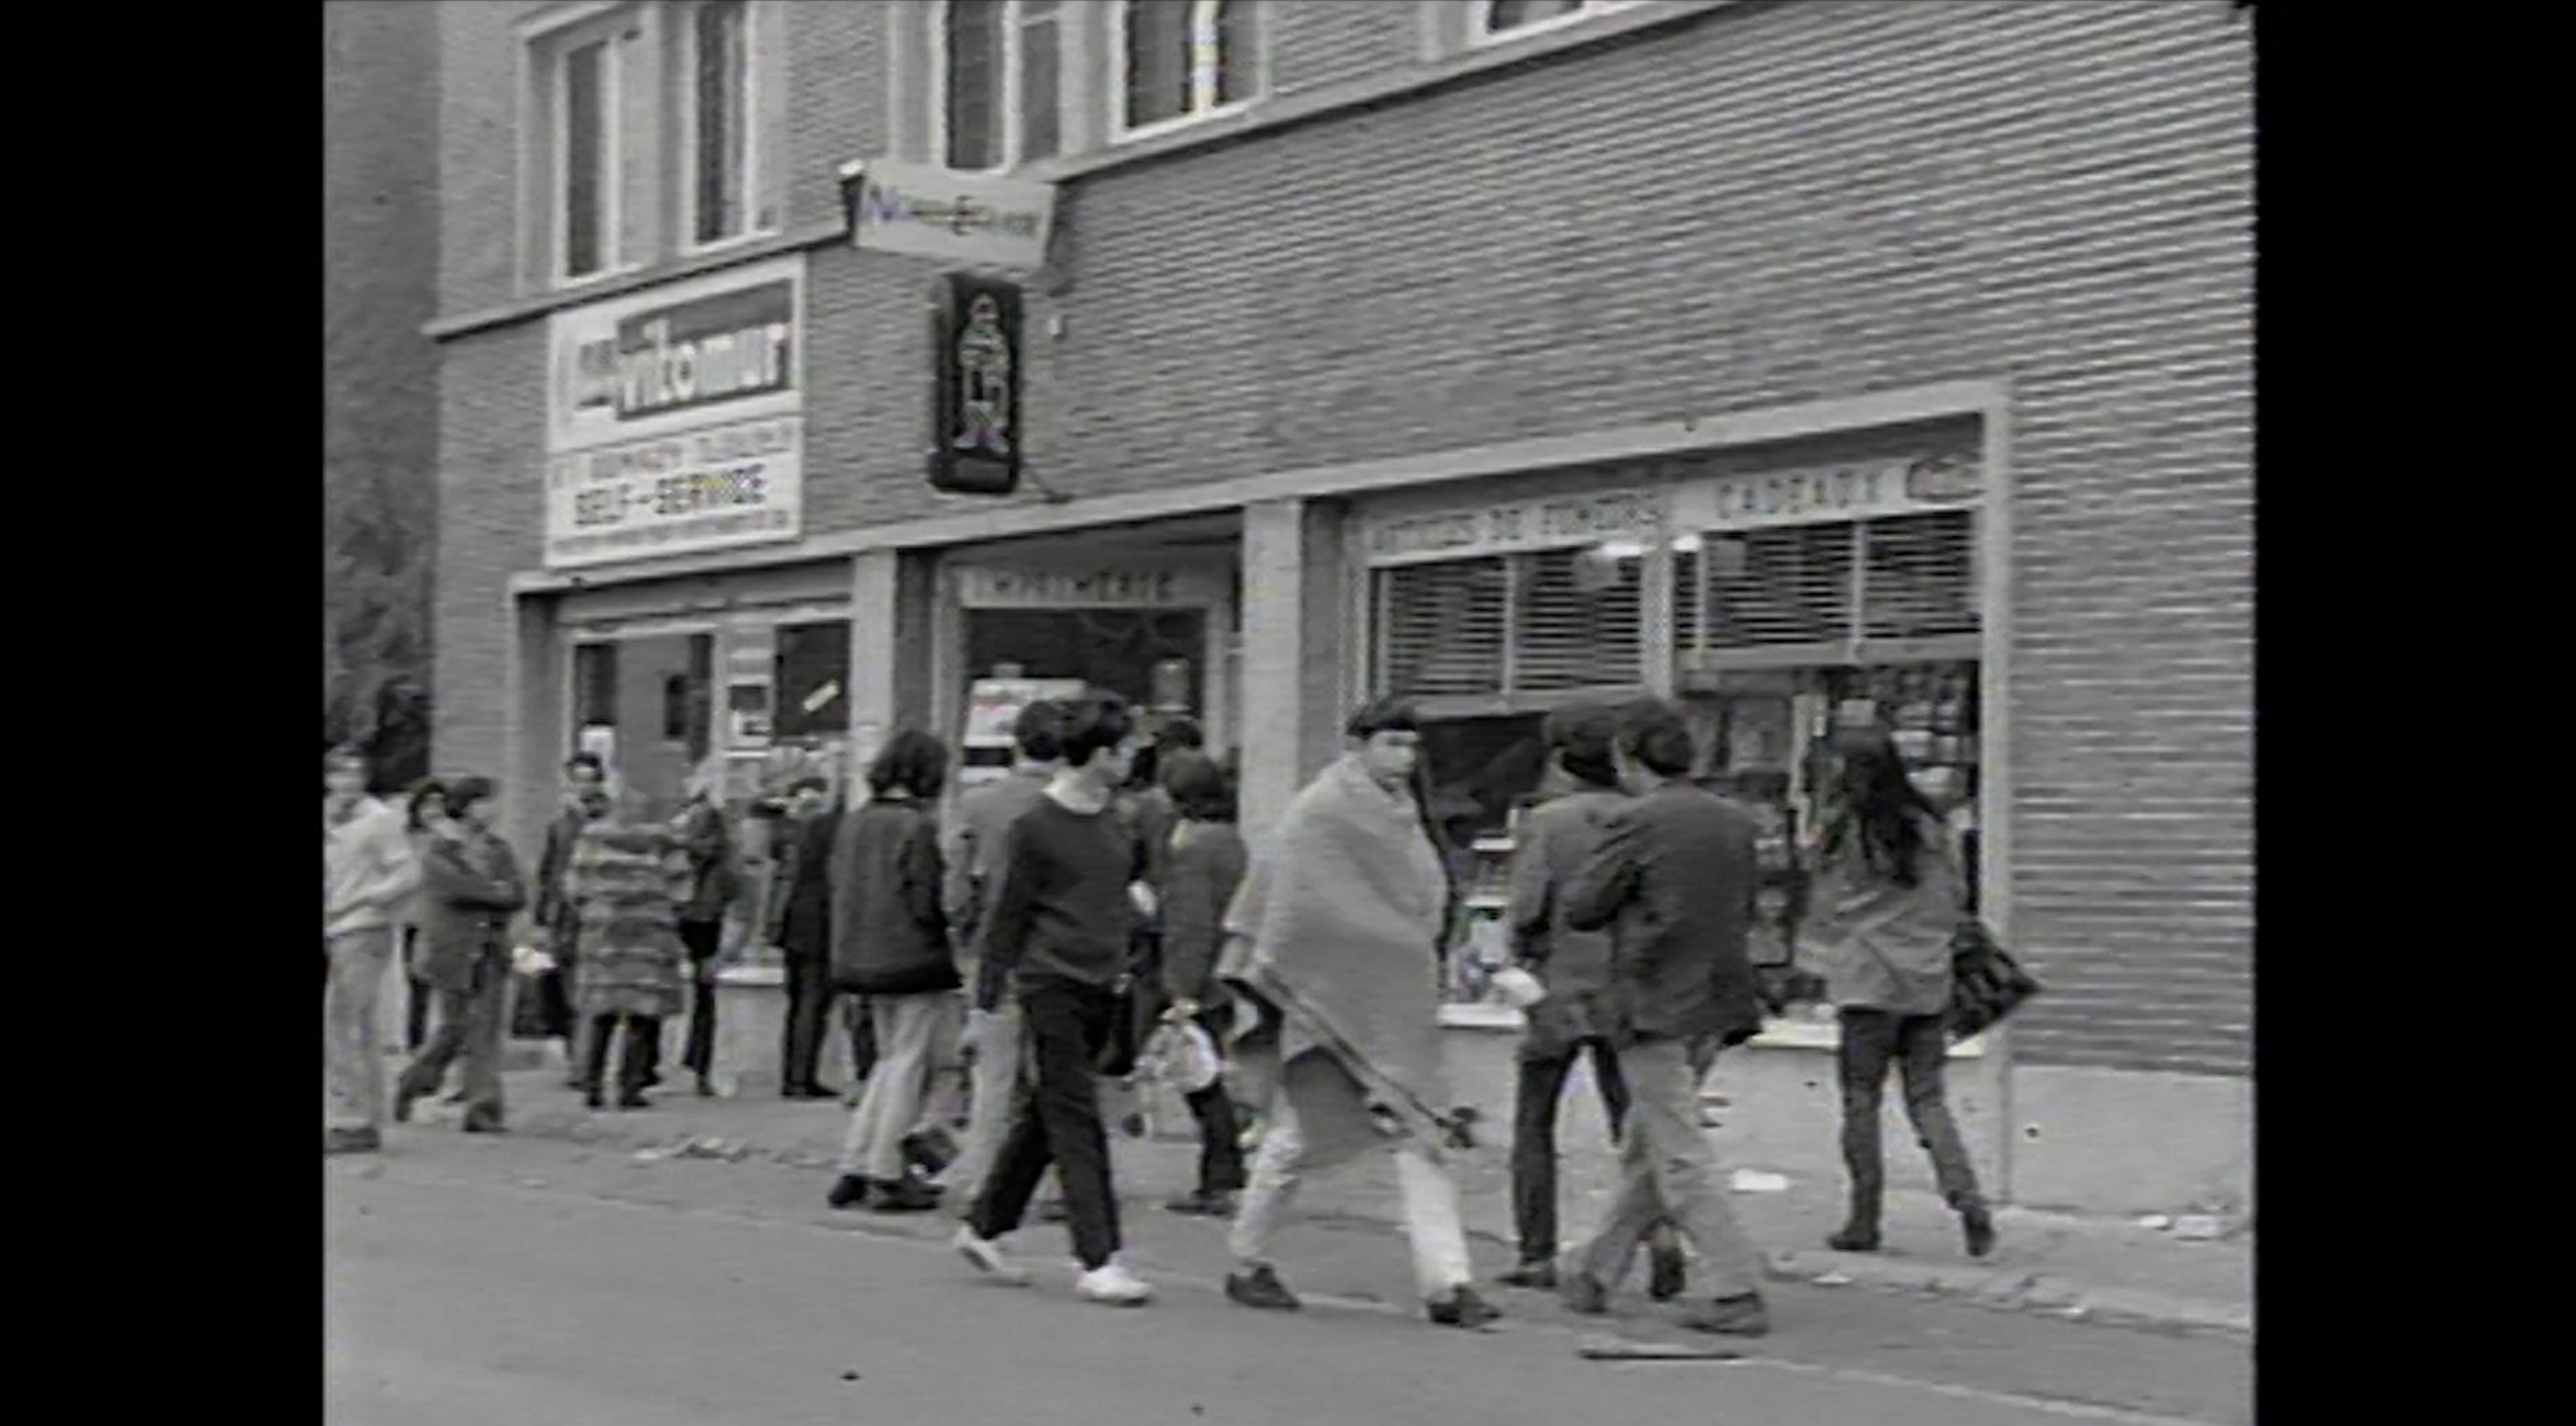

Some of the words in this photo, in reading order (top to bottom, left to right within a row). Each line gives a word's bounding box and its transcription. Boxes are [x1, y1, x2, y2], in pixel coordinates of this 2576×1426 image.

[1716, 467, 1884, 520] CADEAUX
[1488, 507, 1522, 542] DE
[974, 570, 1176, 602] IMPRIMERIE
